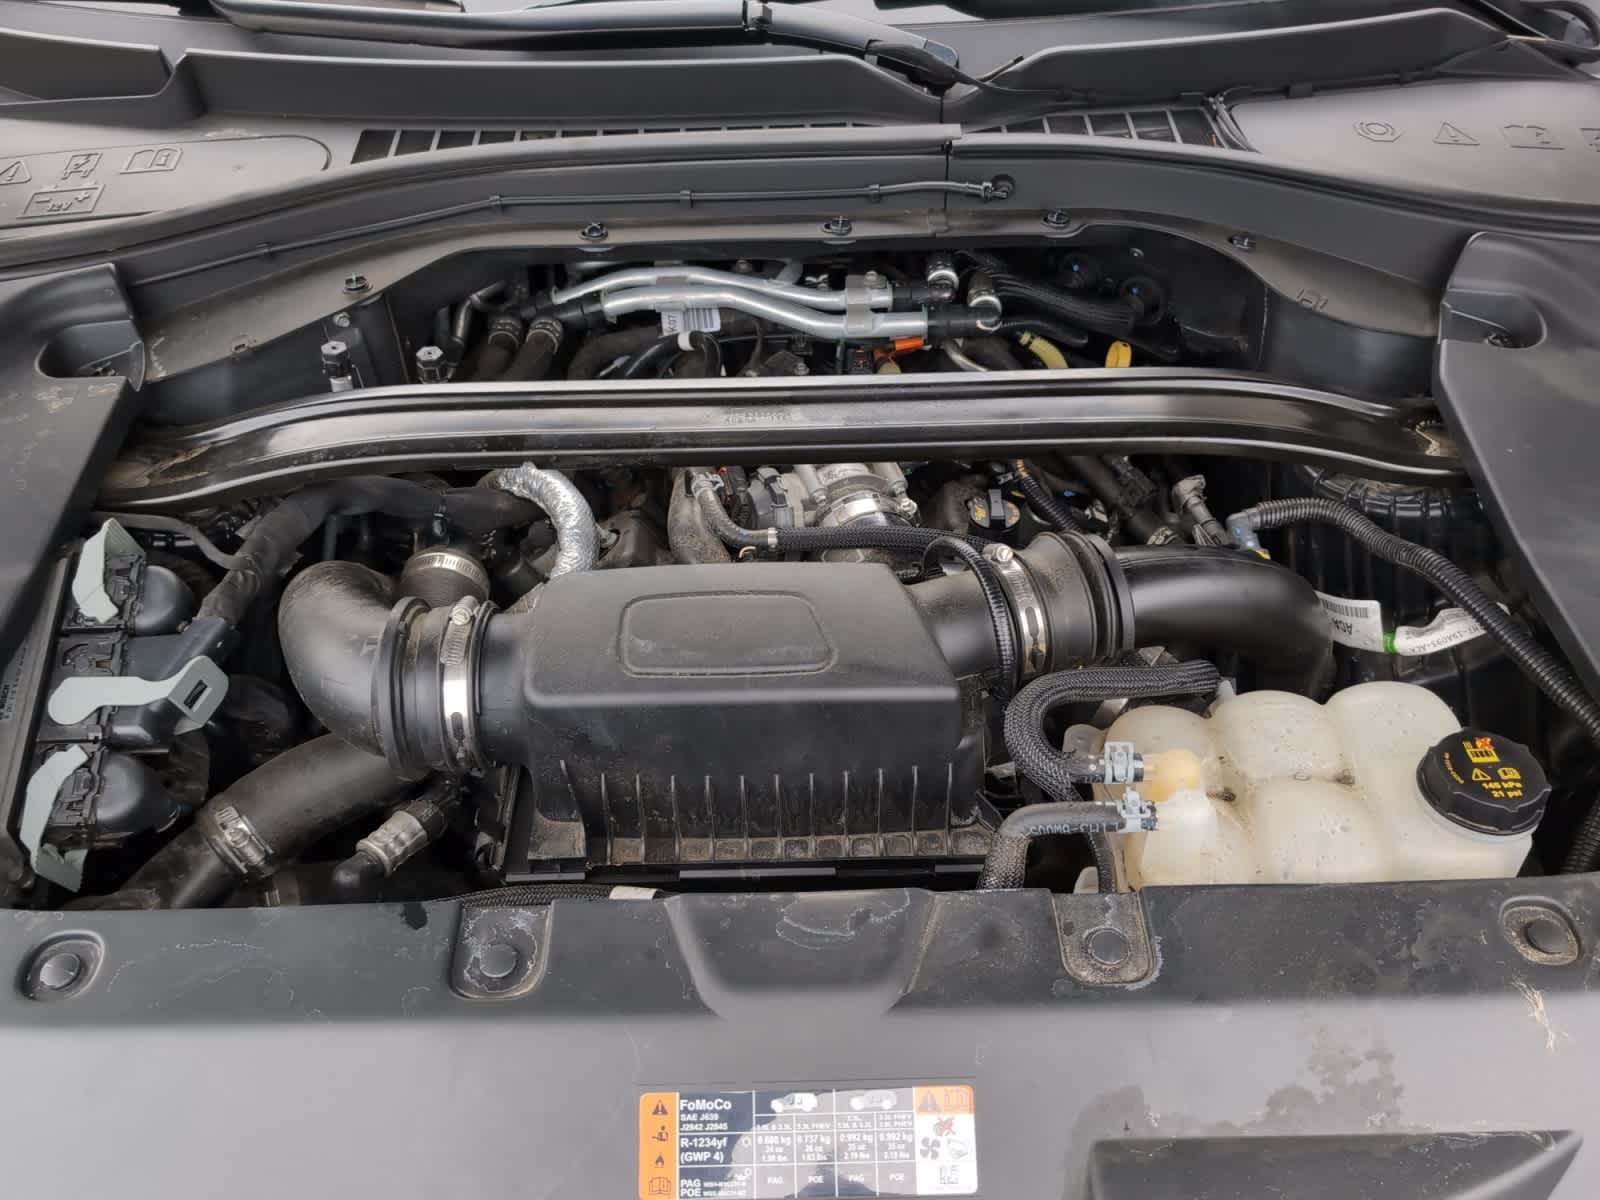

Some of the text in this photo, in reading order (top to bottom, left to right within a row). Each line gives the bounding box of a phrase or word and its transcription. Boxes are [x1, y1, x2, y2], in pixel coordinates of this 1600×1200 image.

[680, 1099, 732, 1111] FoMoCo
[699, 1113, 719, 1121] J639
[680, 1137, 728, 1149] R-1234yf
[680, 1151, 724, 1164] (GWP 4)
[680, 1178, 701, 1188] PAG
[680, 1188, 701, 1198] POE
